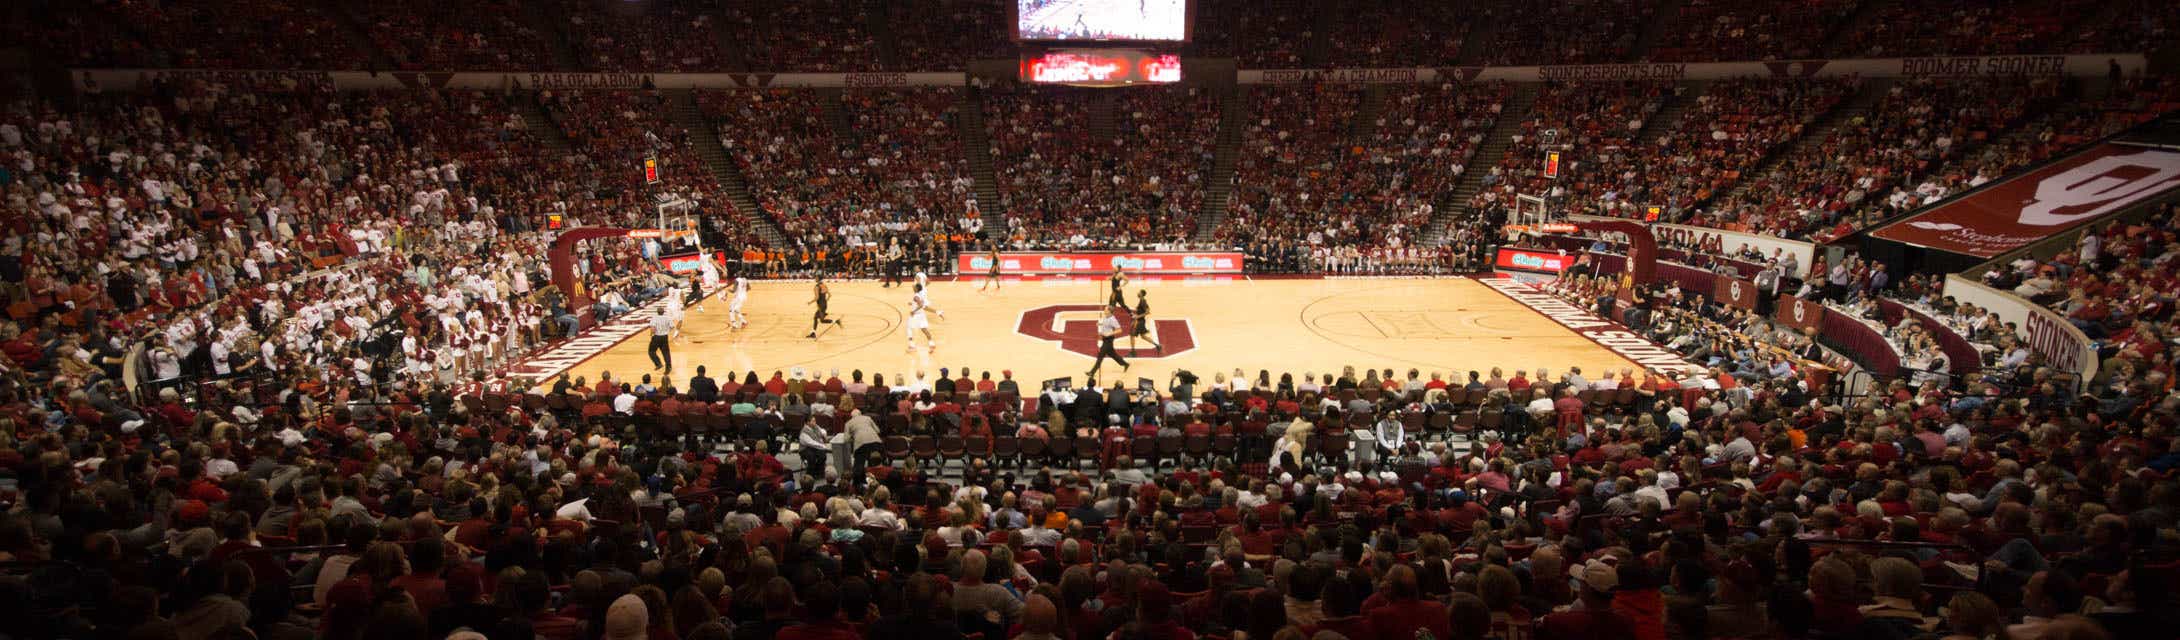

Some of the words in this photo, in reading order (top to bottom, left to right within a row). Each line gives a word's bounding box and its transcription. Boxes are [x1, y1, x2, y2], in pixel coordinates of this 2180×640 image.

[1538, 64, 1686, 81] SOONERSPORTS.COM
[1902, 57, 1980, 75] BOOMER
[1986, 55, 2065, 74] SOONER
[567, 73, 650, 88] OKLAHOM
[845, 72, 907, 87] #SOONERS
[1351, 70, 1416, 82] CHAMPION
[2024, 310, 2081, 369] SOONERS
